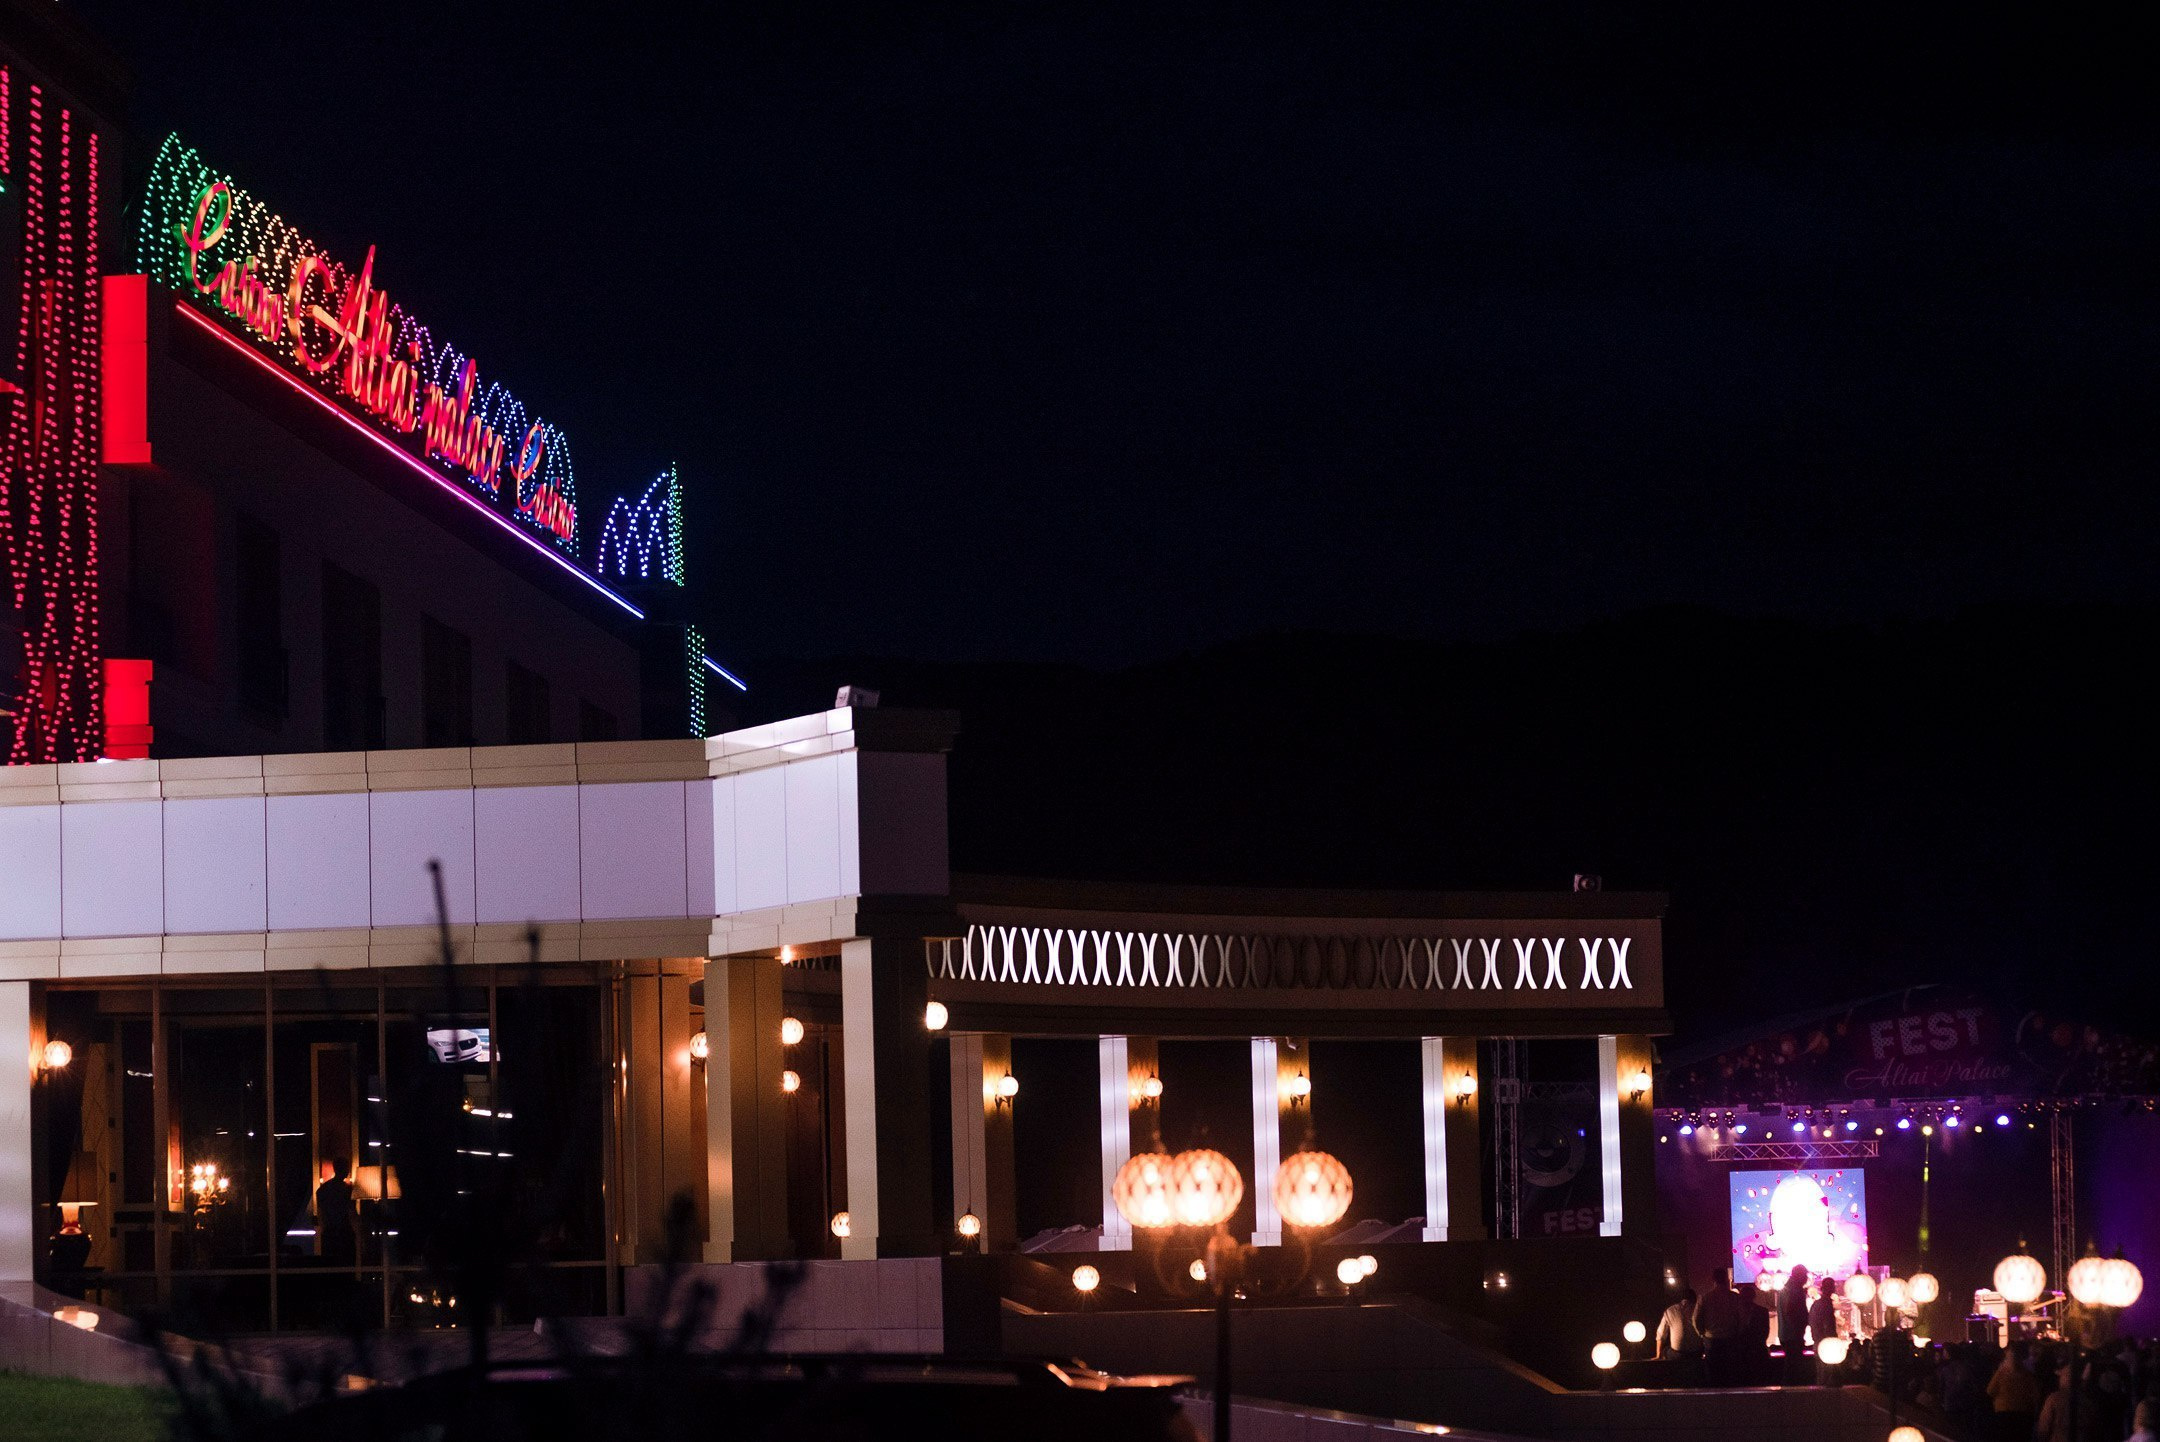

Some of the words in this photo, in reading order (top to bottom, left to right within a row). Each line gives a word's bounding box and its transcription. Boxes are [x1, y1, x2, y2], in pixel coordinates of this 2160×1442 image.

[173, 182, 283, 342] Casino
[287, 245, 420, 433] Altai
[507, 424, 575, 542] Casino
[1869, 1006, 1985, 1060] FEST
[1844, 1057, 1929, 1088] Altai
[1930, 1056, 2011, 1086] Palace
